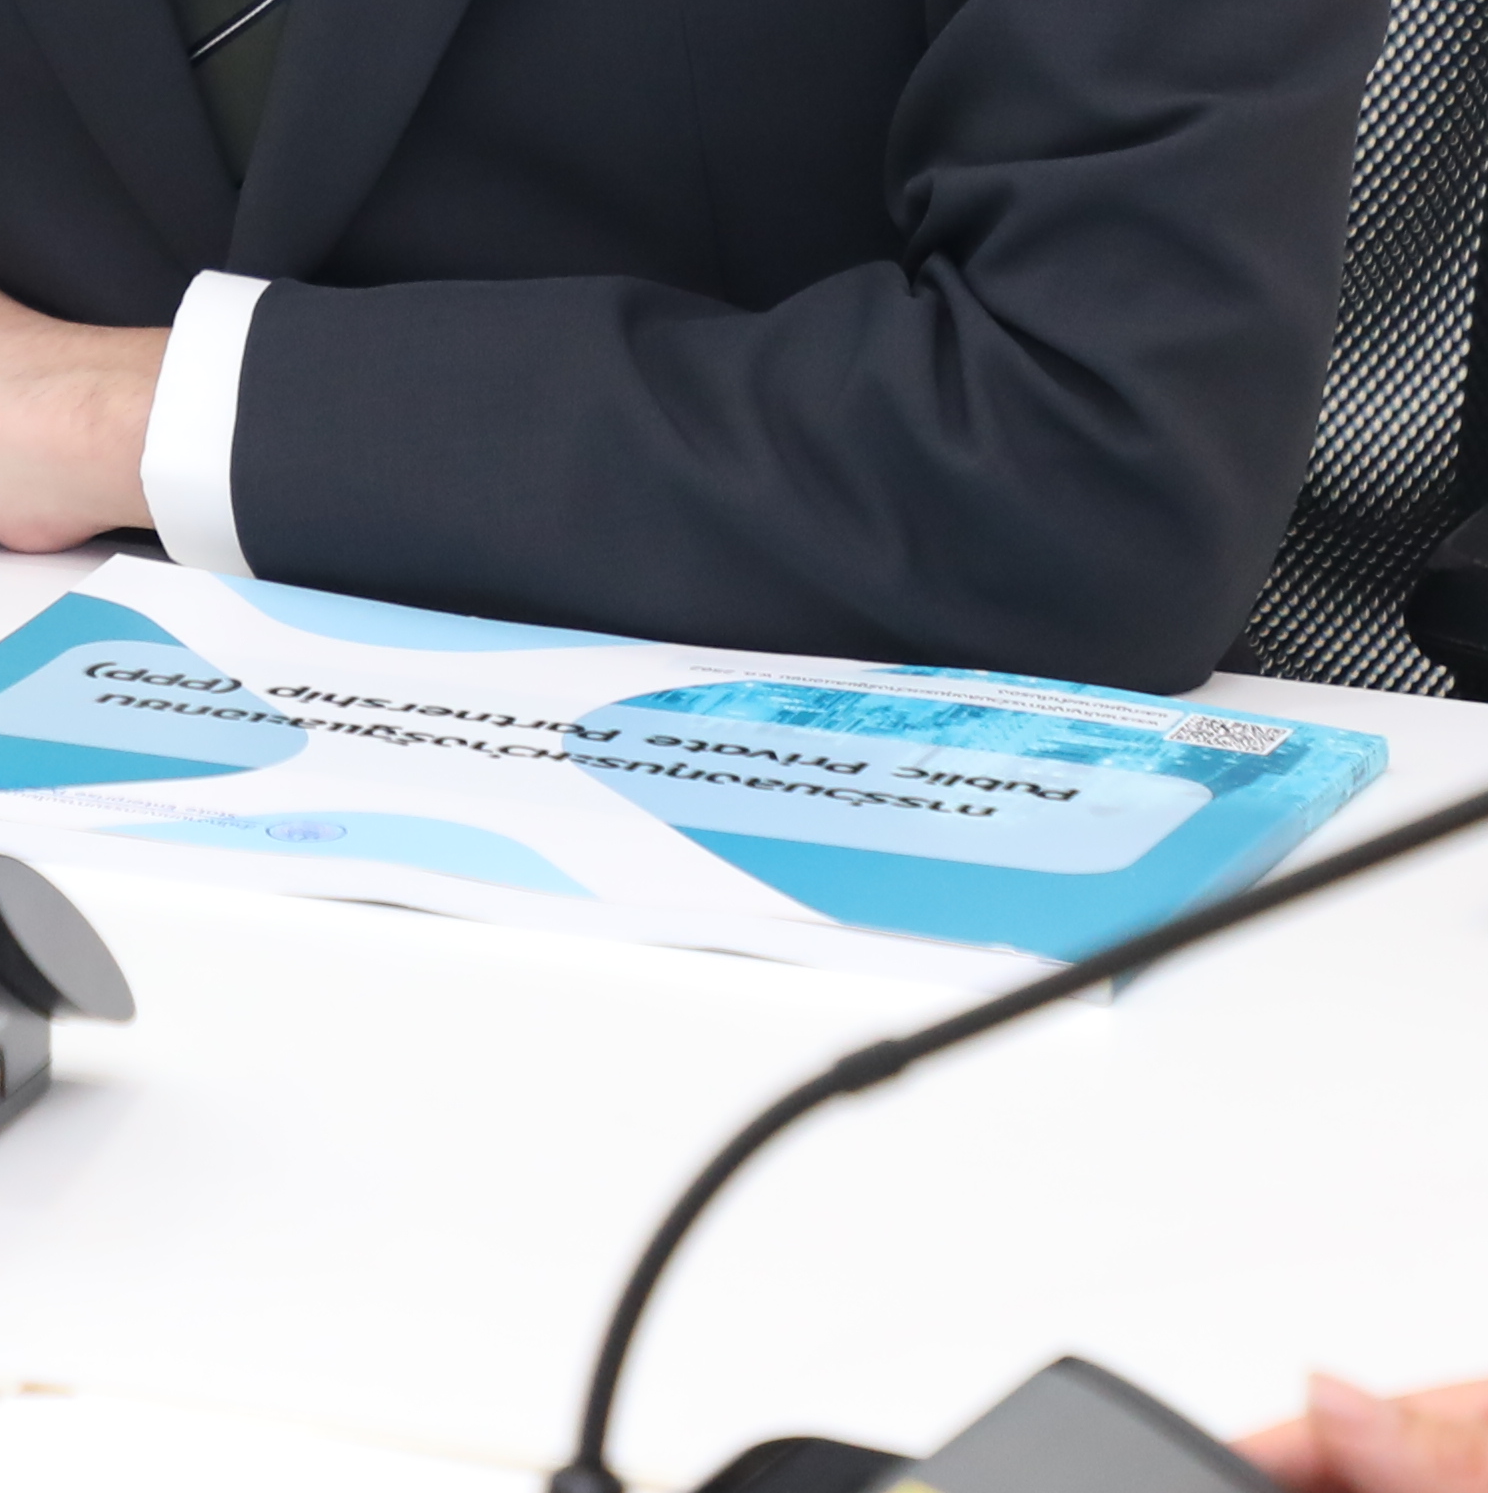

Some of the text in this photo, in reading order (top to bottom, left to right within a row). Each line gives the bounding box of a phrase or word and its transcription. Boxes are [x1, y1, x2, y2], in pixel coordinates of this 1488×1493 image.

[84, 661, 1079, 801] Public Private Partnership (PPP)
[94, 692, 996, 818] การร่วมลงทุนระหว่างรัฐและเอกชน
